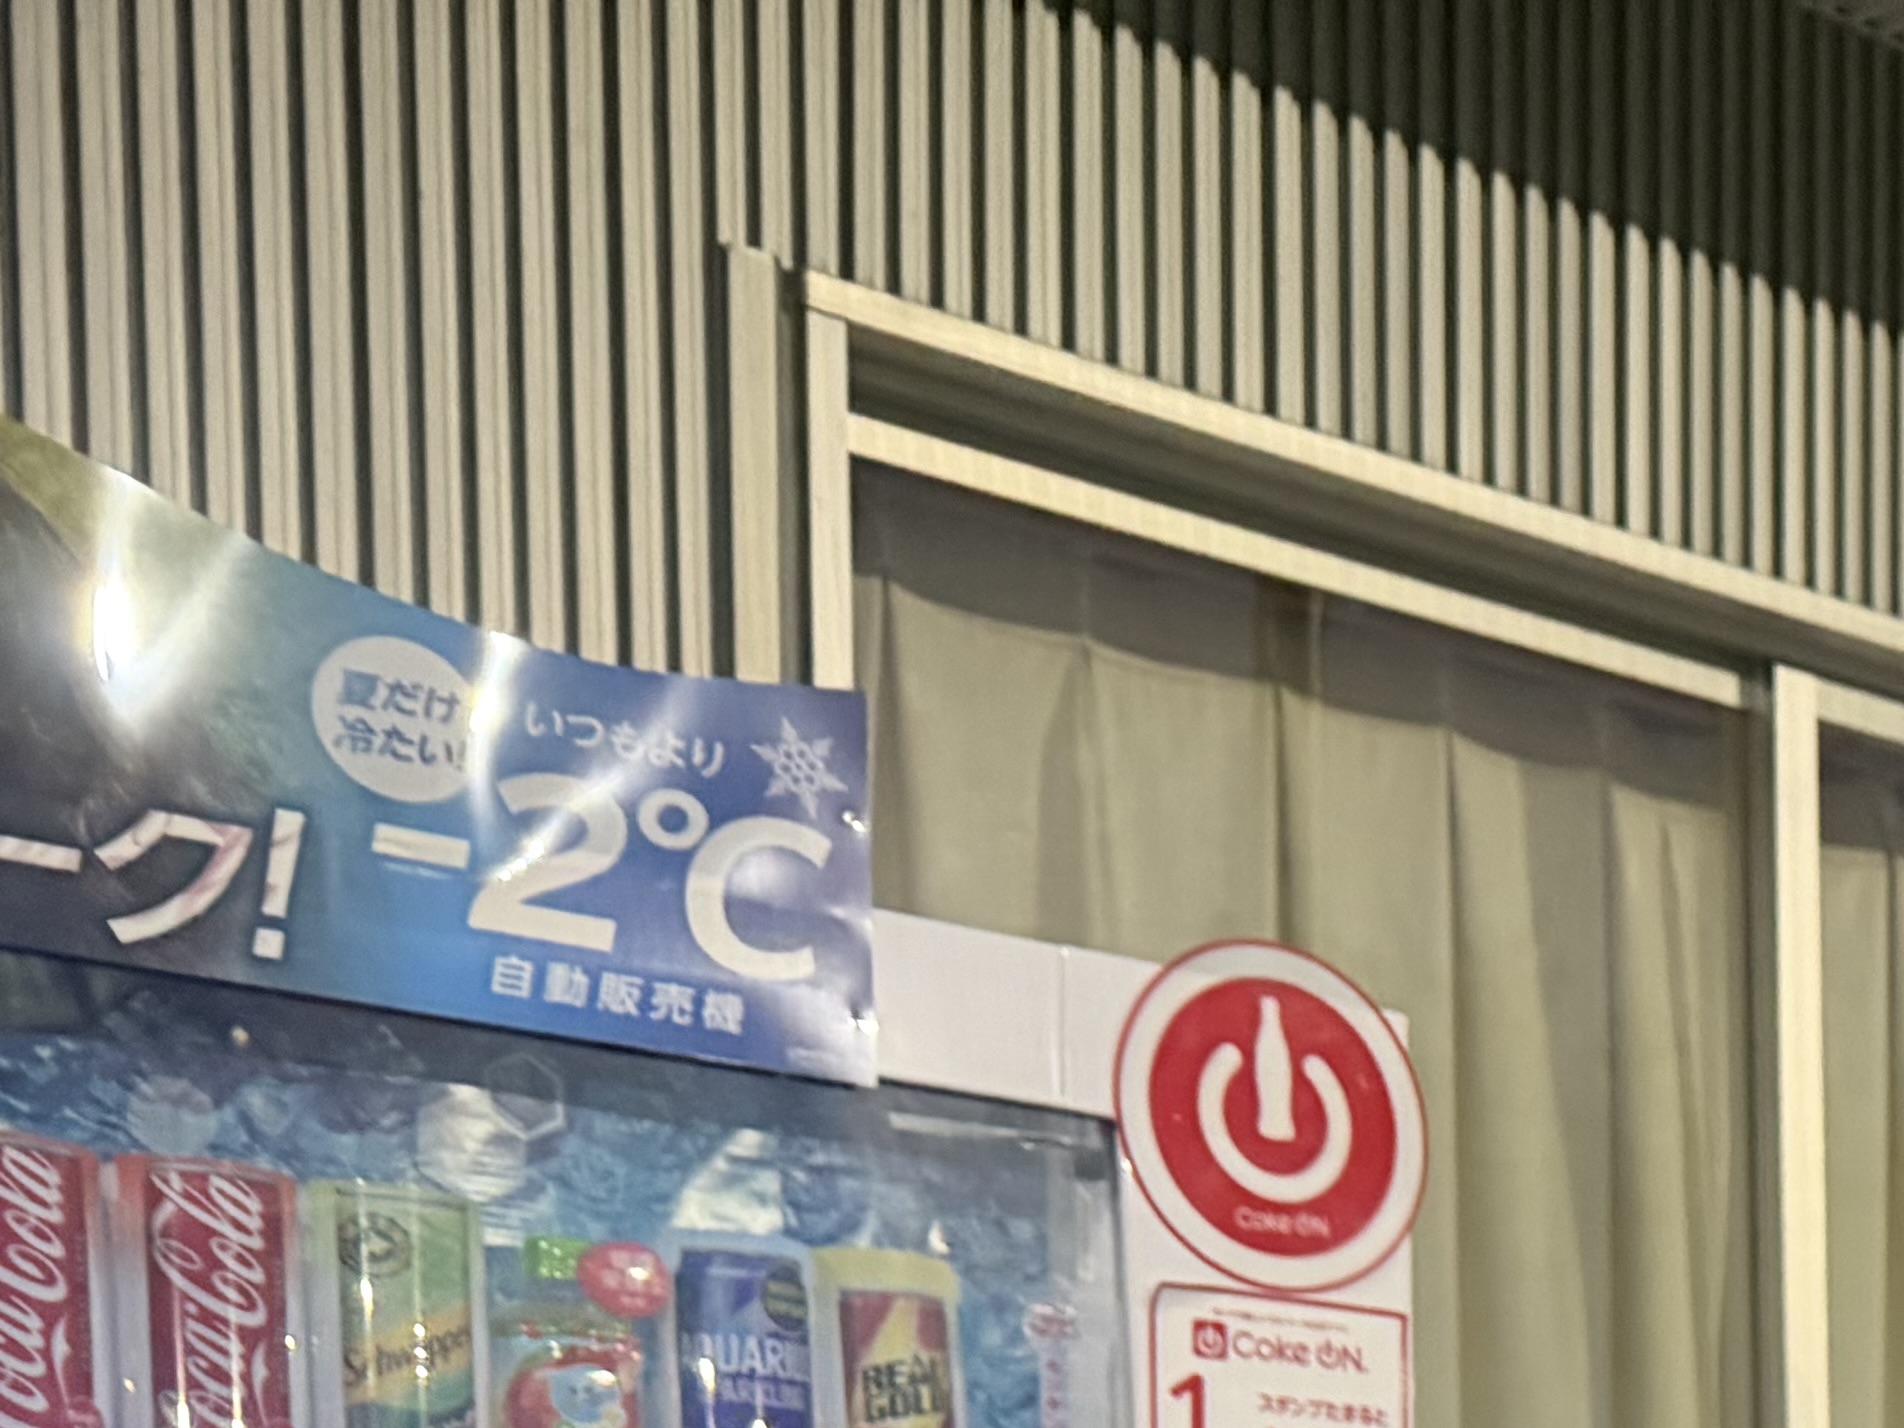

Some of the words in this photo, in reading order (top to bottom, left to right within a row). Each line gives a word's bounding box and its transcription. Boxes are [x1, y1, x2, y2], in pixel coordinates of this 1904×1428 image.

[336, 668, 462, 720] 夏だけ
[525, 708, 725, 778] いつもより
[490, 953, 745, 1036] 自動販売機
